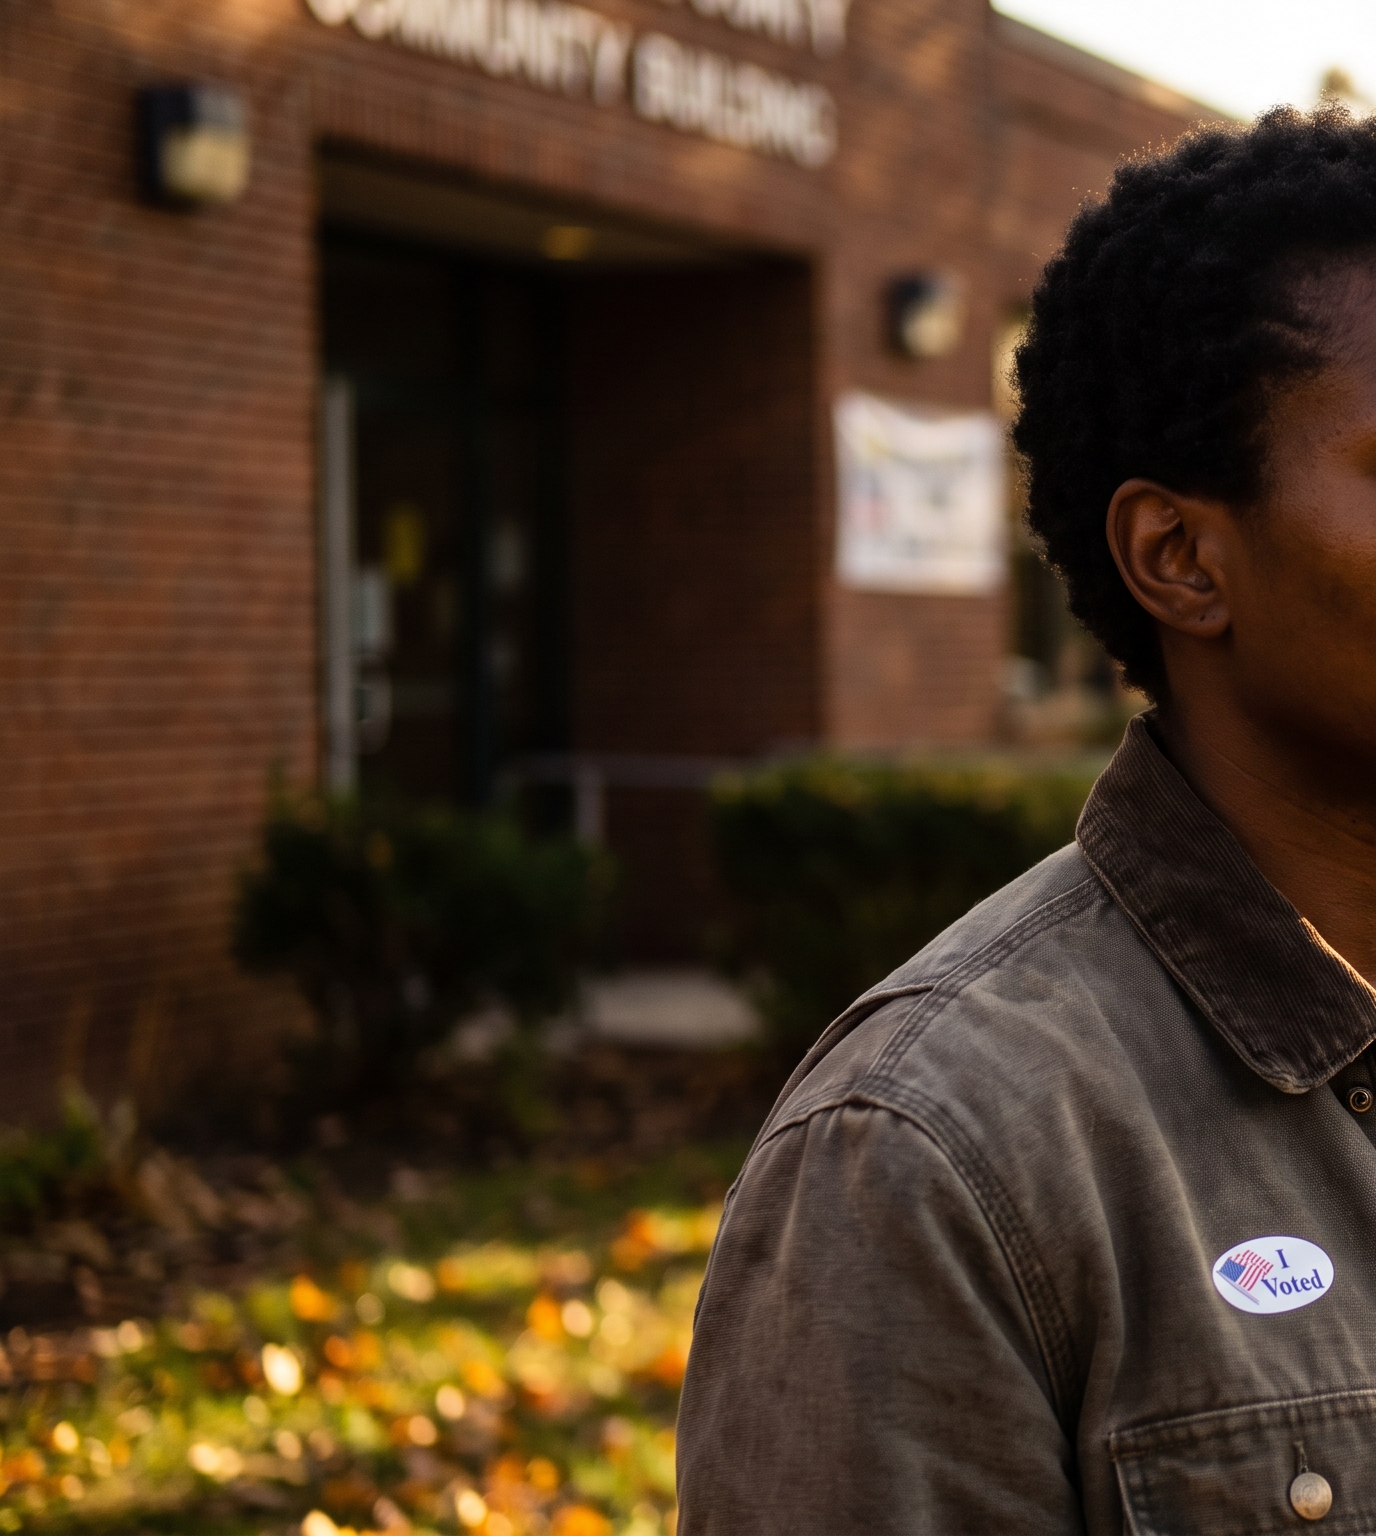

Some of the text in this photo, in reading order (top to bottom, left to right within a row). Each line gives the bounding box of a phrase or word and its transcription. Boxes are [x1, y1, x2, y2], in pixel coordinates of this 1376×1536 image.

[634, 31, 838, 169] BUILDING
[1275, 1249, 1290, 1269] I
[1261, 1269, 1325, 1298] Voted
